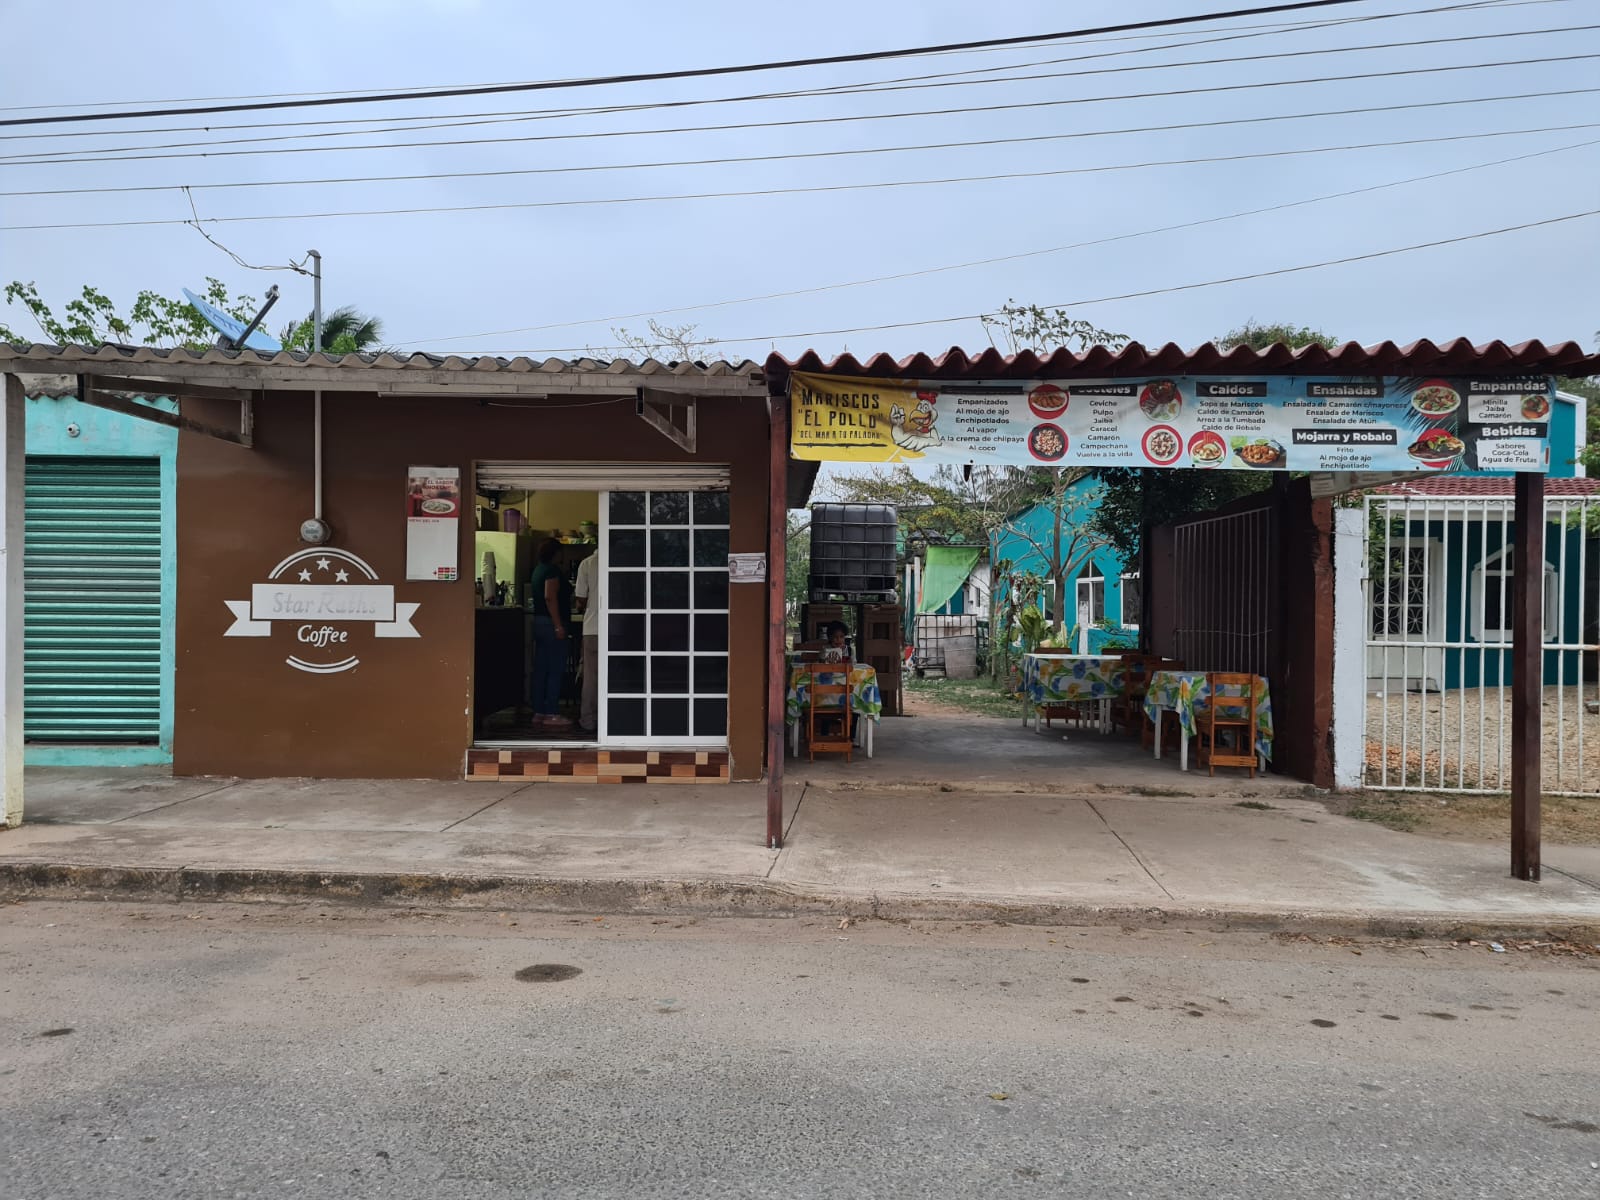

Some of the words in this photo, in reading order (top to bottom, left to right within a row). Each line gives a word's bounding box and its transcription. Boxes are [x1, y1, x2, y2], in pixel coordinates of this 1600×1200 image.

[1209, 385, 1254, 394] Caldos
[1312, 386, 1378, 396] Ensaladas
[1470, 381, 1547, 393] Empanadas
[802, 389, 880, 408] MARISCOS
[958, 398, 1008, 406] Empanizados
[966, 408, 984, 416] mojo
[998, 408, 1010, 416] ajo
[839, 430, 846, 439] TU
[1482, 426, 1537, 436] Bebidas
[1296, 432, 1340, 442] Mojarra
[1342, 434, 1350, 442] y
[1352, 432, 1393, 441] Robalo
[272, 592, 314, 614] Star
[297, 624, 348, 647] Coffee
